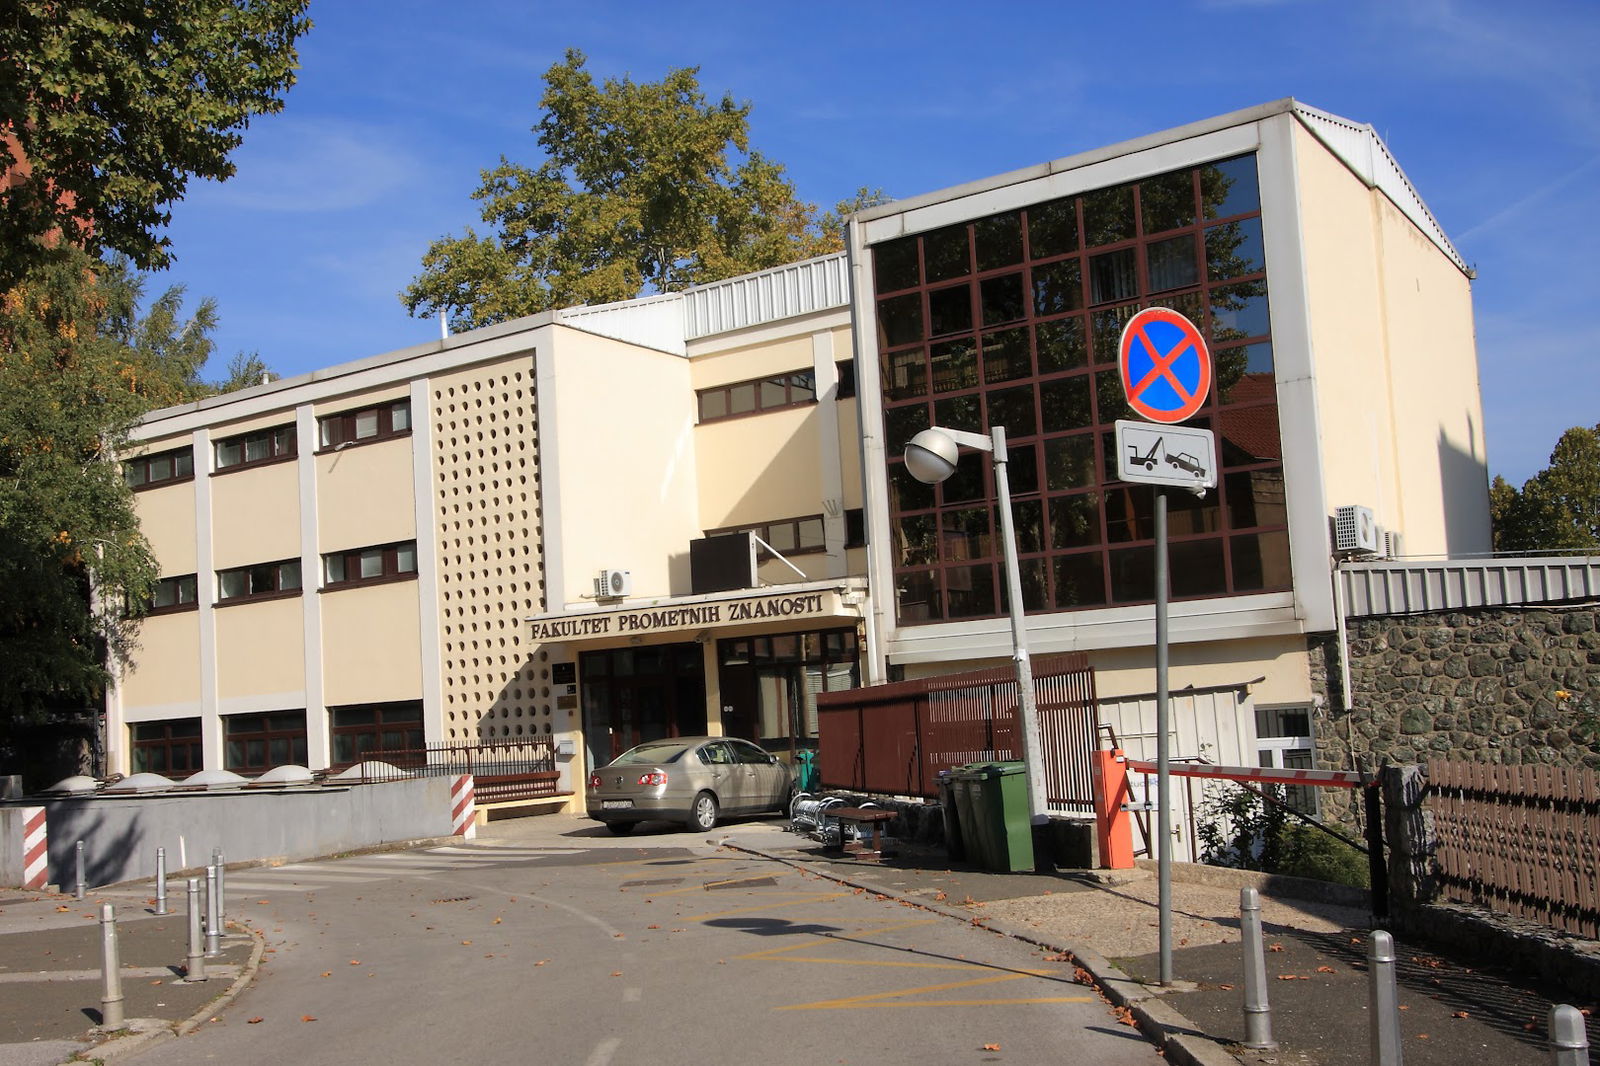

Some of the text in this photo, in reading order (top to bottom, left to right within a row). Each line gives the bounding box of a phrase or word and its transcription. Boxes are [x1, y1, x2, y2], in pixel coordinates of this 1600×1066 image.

[531, 594, 823, 640] FAKULTET PROMETNIH ZNANOSTI
